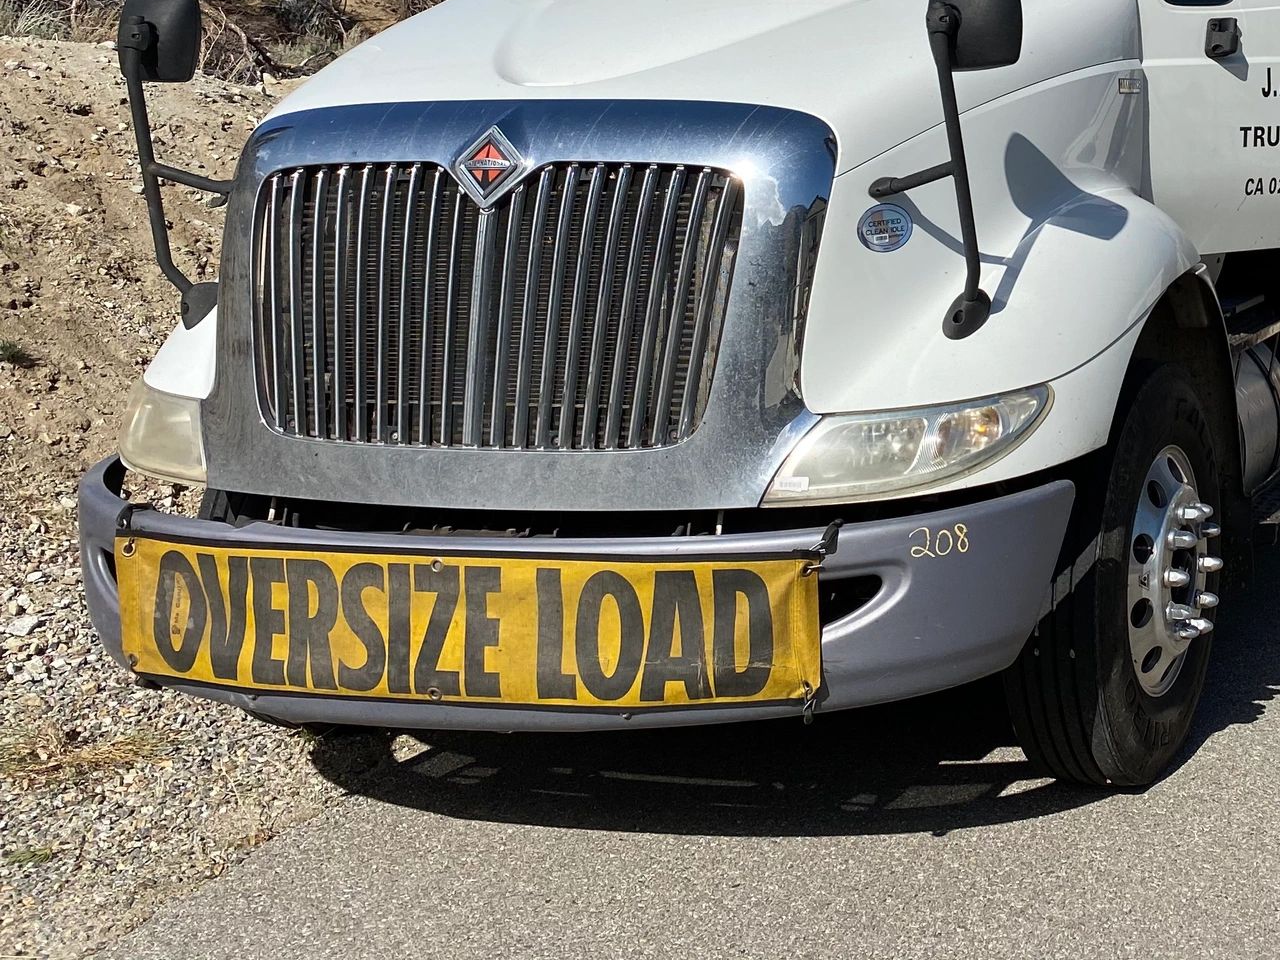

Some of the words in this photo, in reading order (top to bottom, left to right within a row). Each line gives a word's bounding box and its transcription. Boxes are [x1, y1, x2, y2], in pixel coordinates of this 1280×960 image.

[467, 159, 506, 167] NTERNATIONAL
[1245, 177, 1264, 196] CA
[868, 218, 901, 227] CERTIFIED
[866, 227, 889, 235] CLEAN
[891, 225, 905, 233] IDLE
[908, 523, 971, 559] 208
[152, 549, 502, 699] OVERSIZE
[535, 566, 776, 703] LOAD
